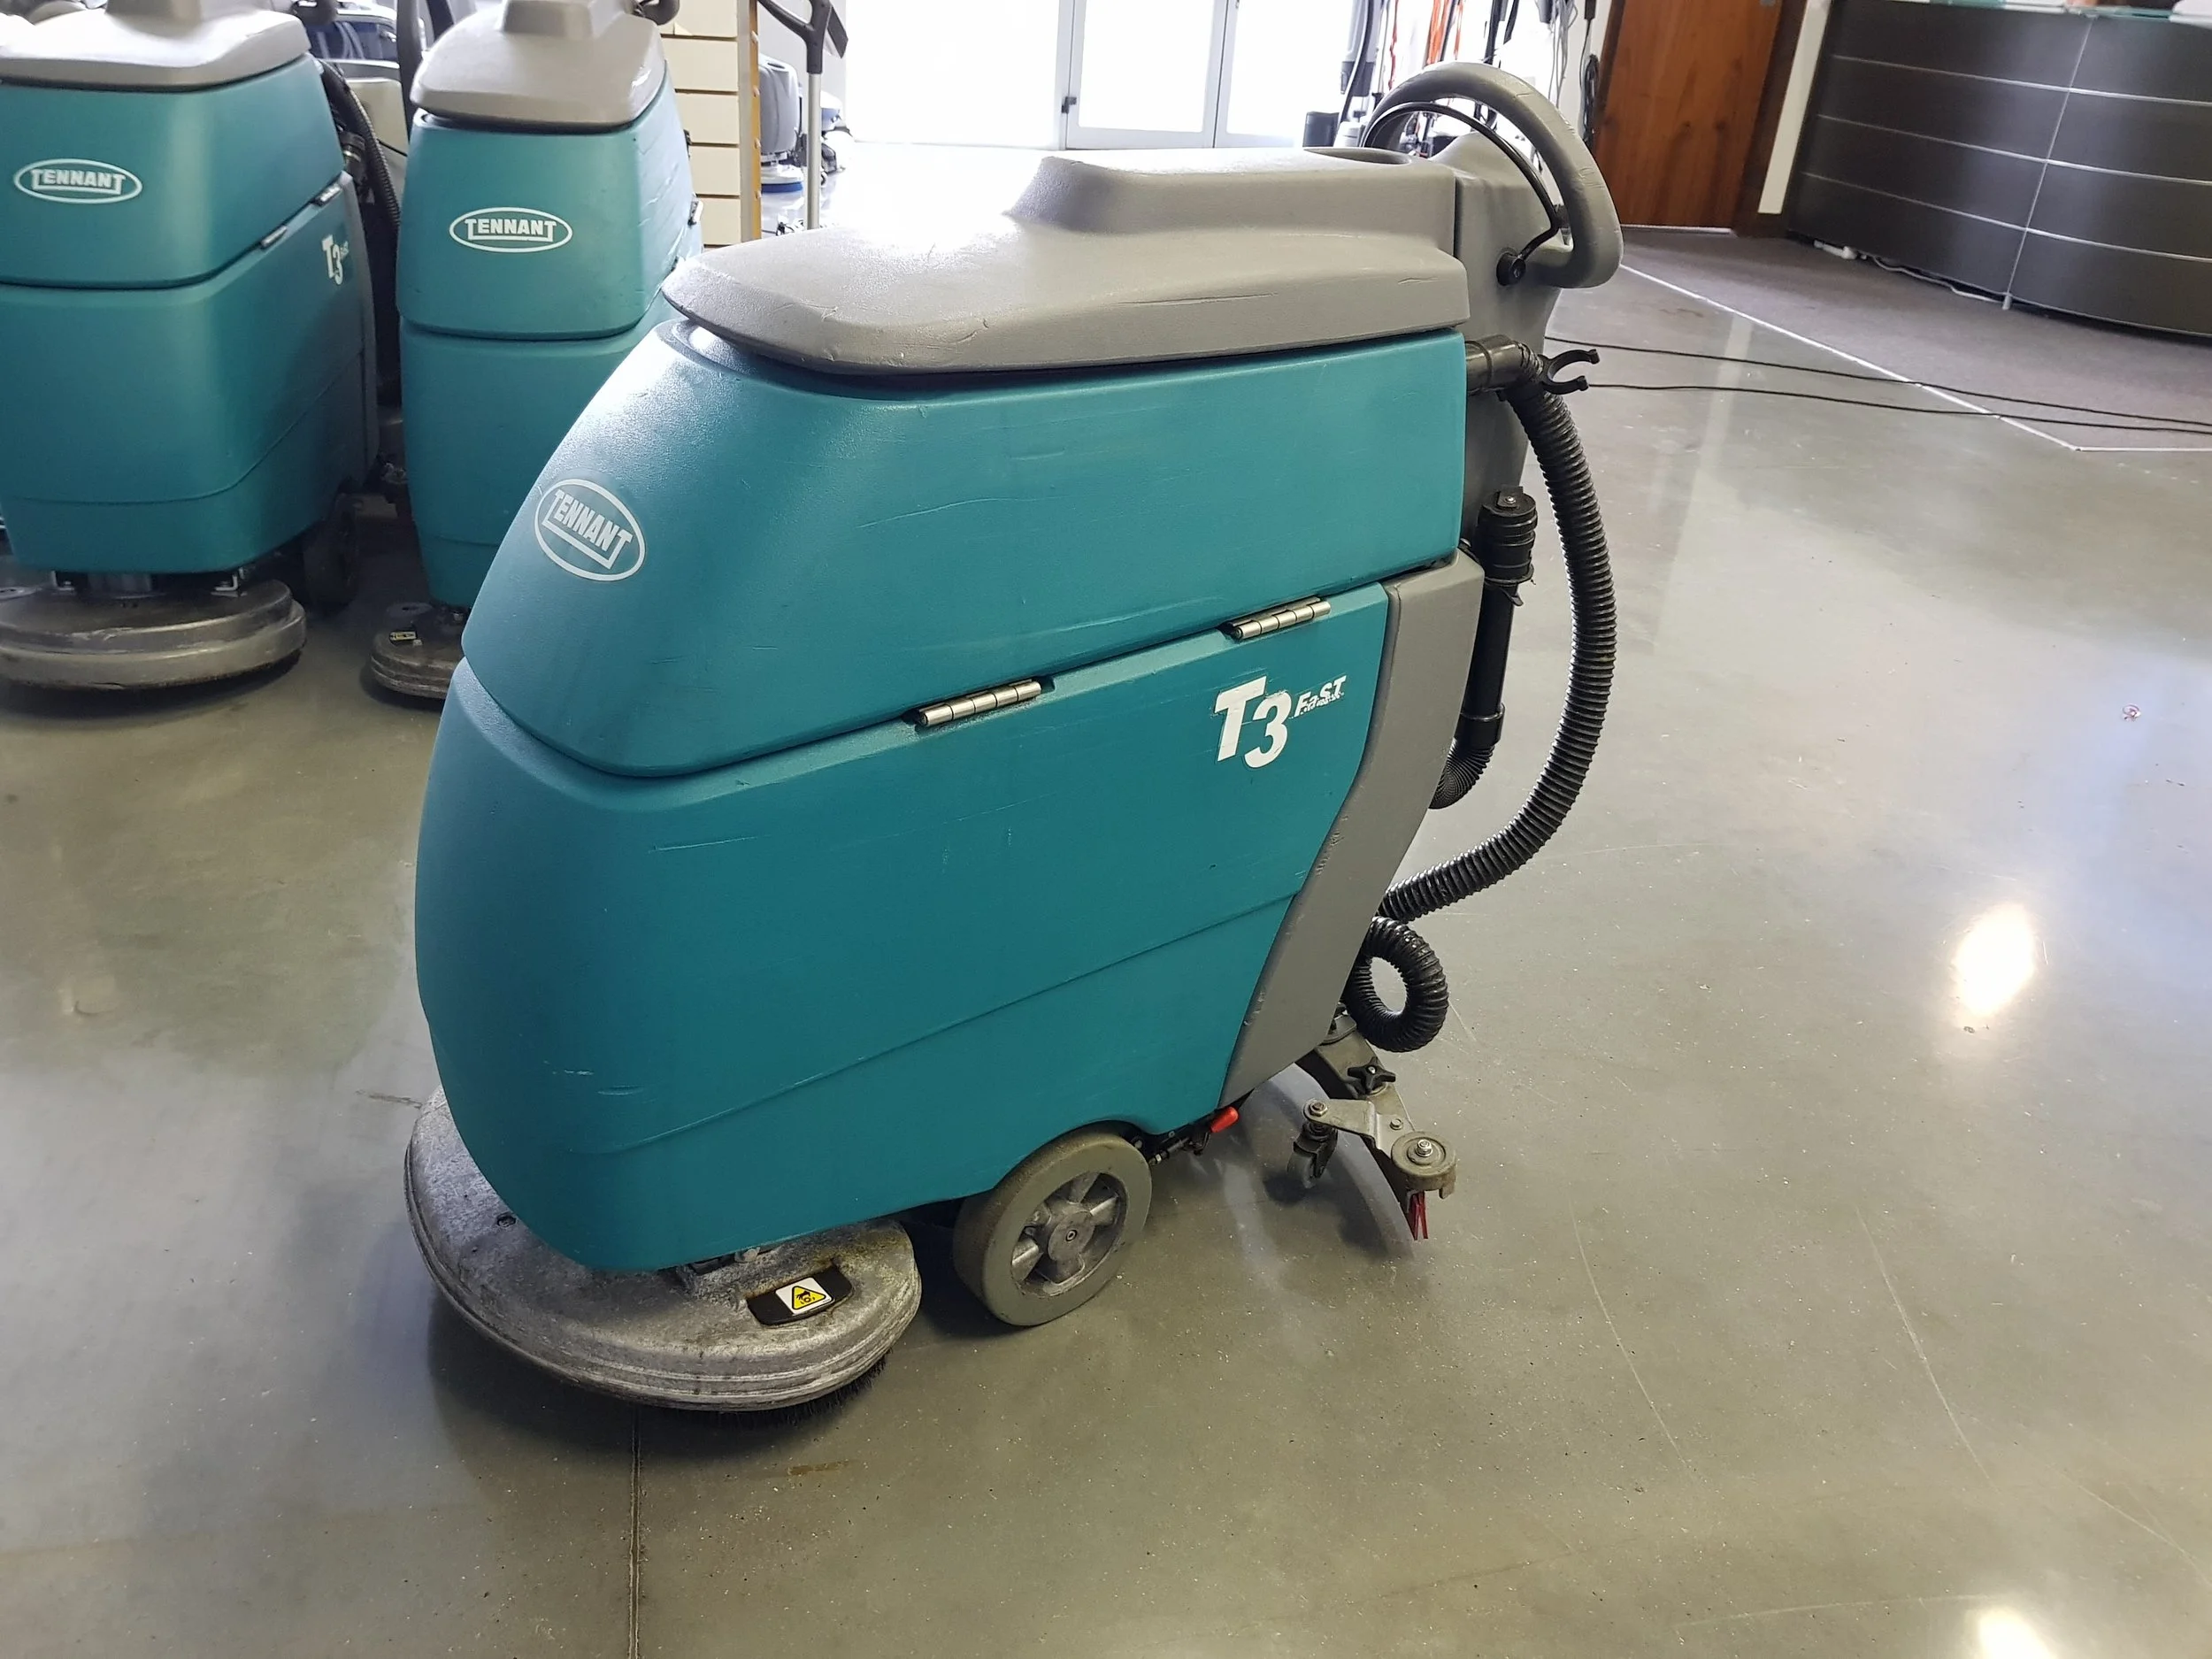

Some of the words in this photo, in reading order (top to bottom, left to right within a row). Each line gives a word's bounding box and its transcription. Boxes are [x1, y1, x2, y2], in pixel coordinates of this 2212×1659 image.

[31, 169, 126, 195] TENNANT
[465, 219, 557, 242] TENNANT
[321, 234, 343, 285] T3
[541, 488, 634, 570] TENNANT
[1214, 675, 1293, 768] T3
